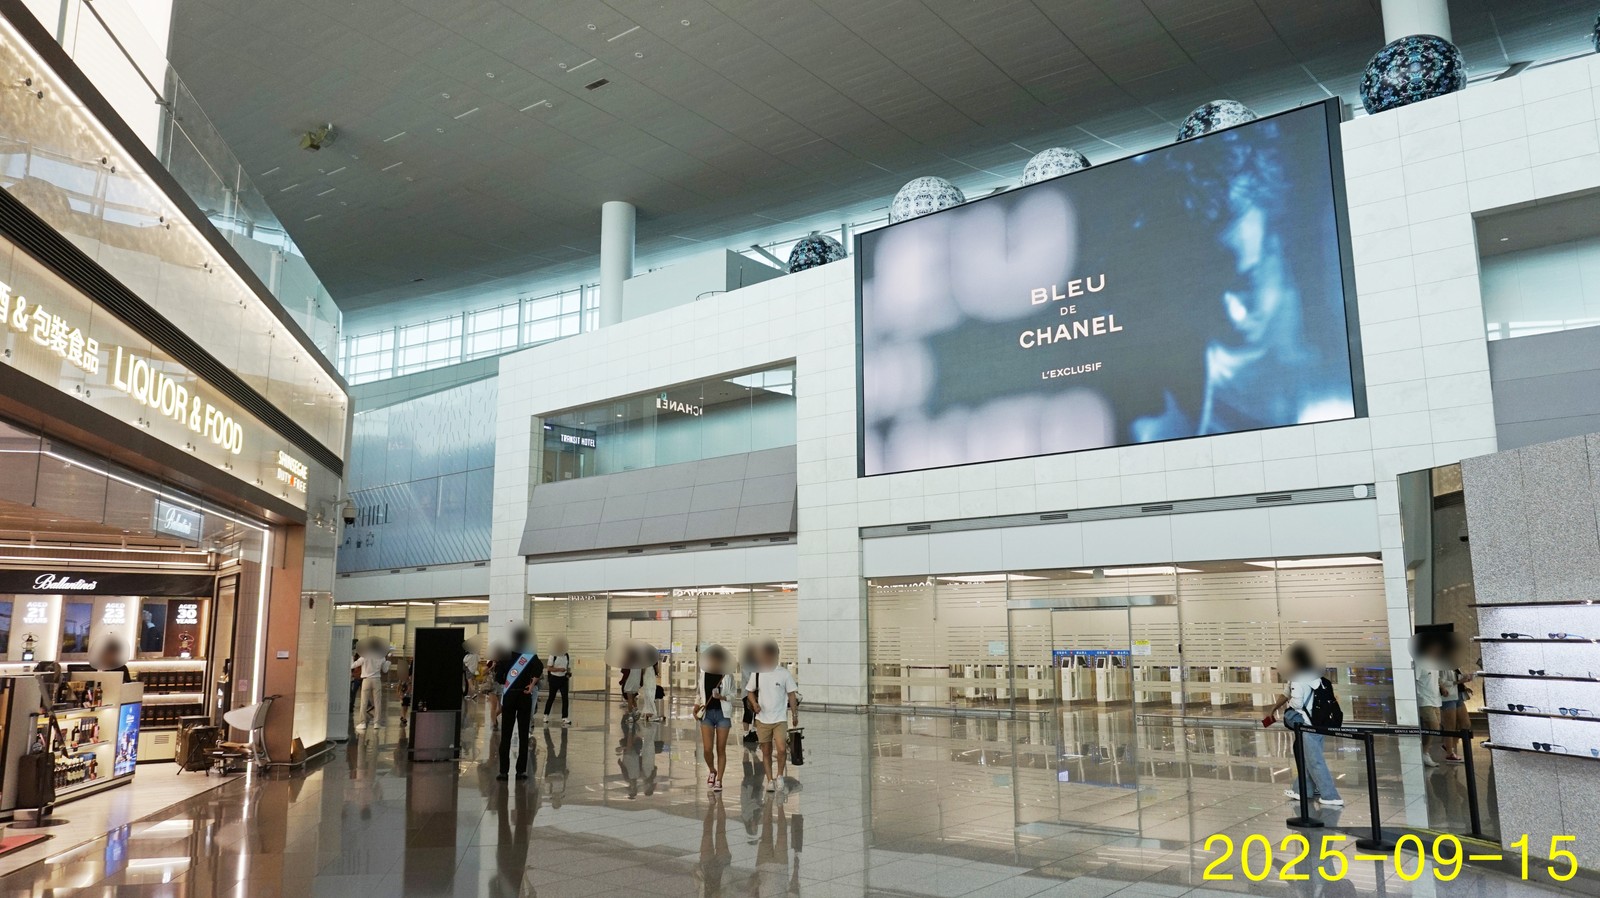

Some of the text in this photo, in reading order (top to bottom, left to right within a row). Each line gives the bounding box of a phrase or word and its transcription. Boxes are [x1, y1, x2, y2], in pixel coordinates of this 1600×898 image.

[1031, 274, 1106, 305] BLEU
[1060, 305, 1077, 316] DE
[13, 296, 28, 332] &
[33, 305, 99, 375] 包裝食品
[1019, 314, 1123, 349] CHANEL
[1042, 362, 1102, 380] L'EXCLUSIF
[114, 346, 243, 455] LIQUOR & FOOD
[561, 434, 595, 448] TRANSIT HOTEL
[33, 573, 98, 590] Ballantine's
[27, 607, 45, 618] 21
[104, 608, 125, 618] 23
[177, 609, 197, 619] 30
